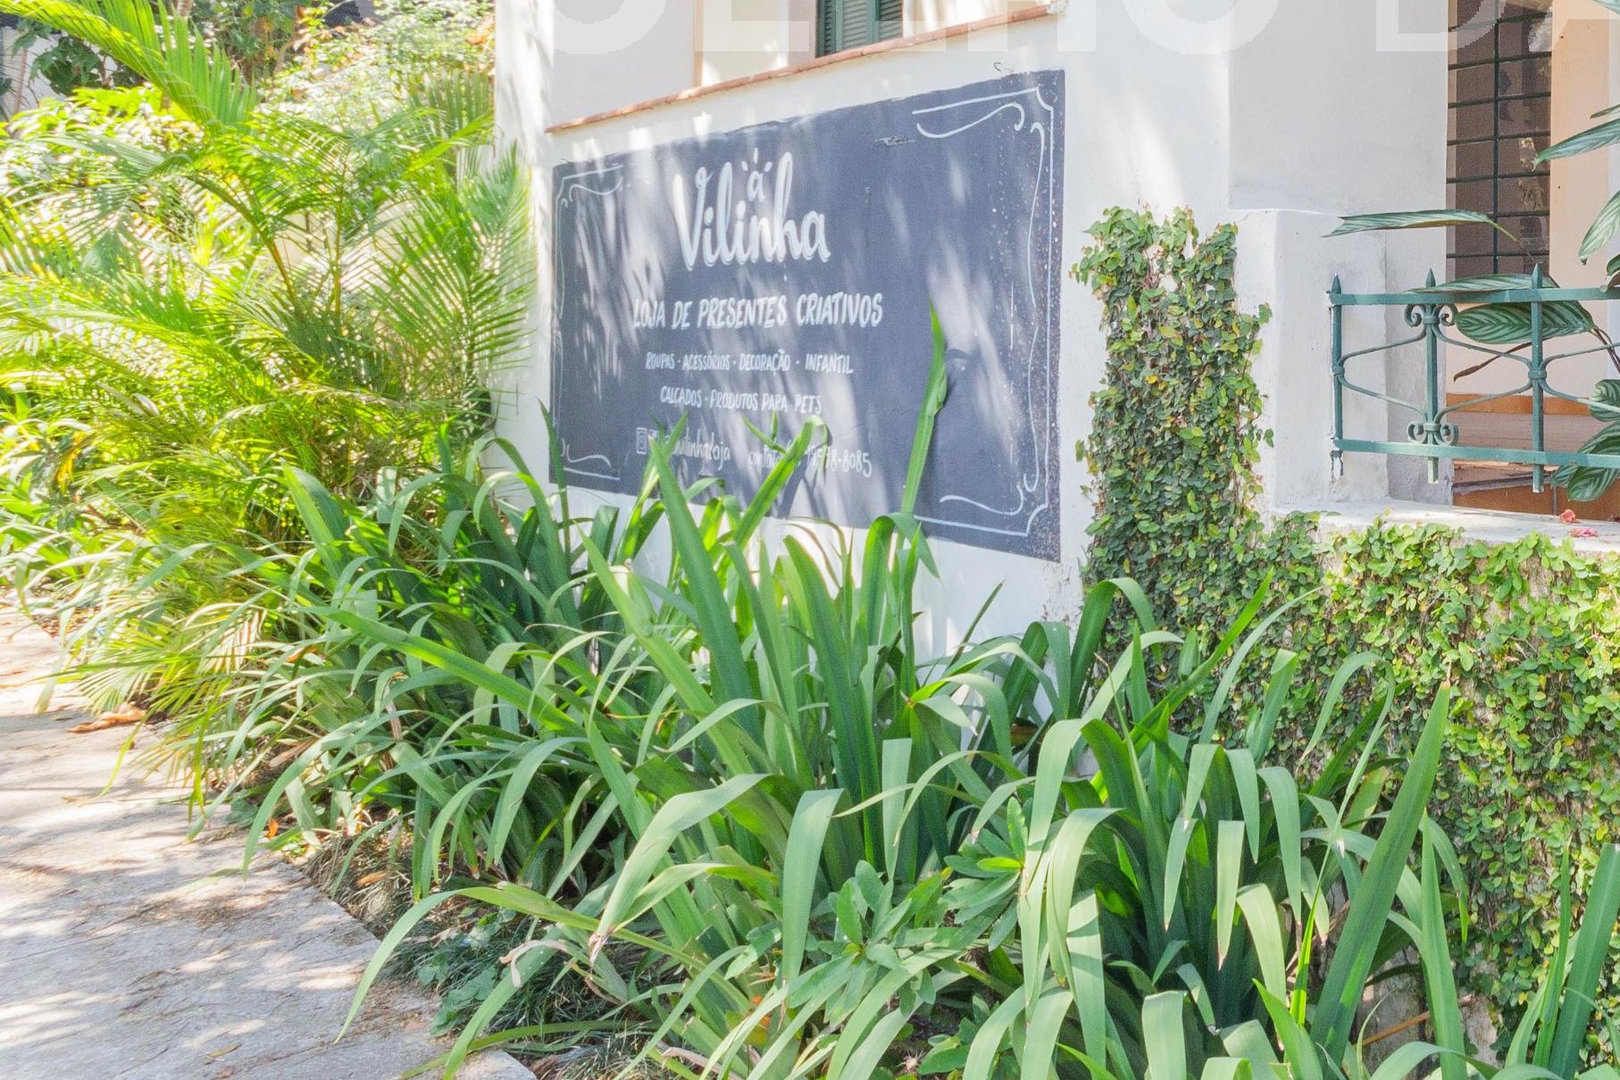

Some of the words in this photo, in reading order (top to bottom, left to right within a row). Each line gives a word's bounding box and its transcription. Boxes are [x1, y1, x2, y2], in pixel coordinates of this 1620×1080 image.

[672, 152, 831, 271] Vilinha
[633, 299, 666, 329] LOJA
[671, 301, 692, 330] DE
[697, 295, 788, 329] PRESENTES
[796, 291, 883, 328] CRIATIVOS
[645, 351, 675, 370] ROUPAS
[682, 349, 730, 371] ACESSÓRIOS
[738, 348, 791, 375] DECORAÇÃO
[805, 353, 854, 374] INFANTIL
[710, 389, 758, 412] PRODUTOS
[761, 392, 788, 414] PARA
[794, 394, 822, 415] PETS
